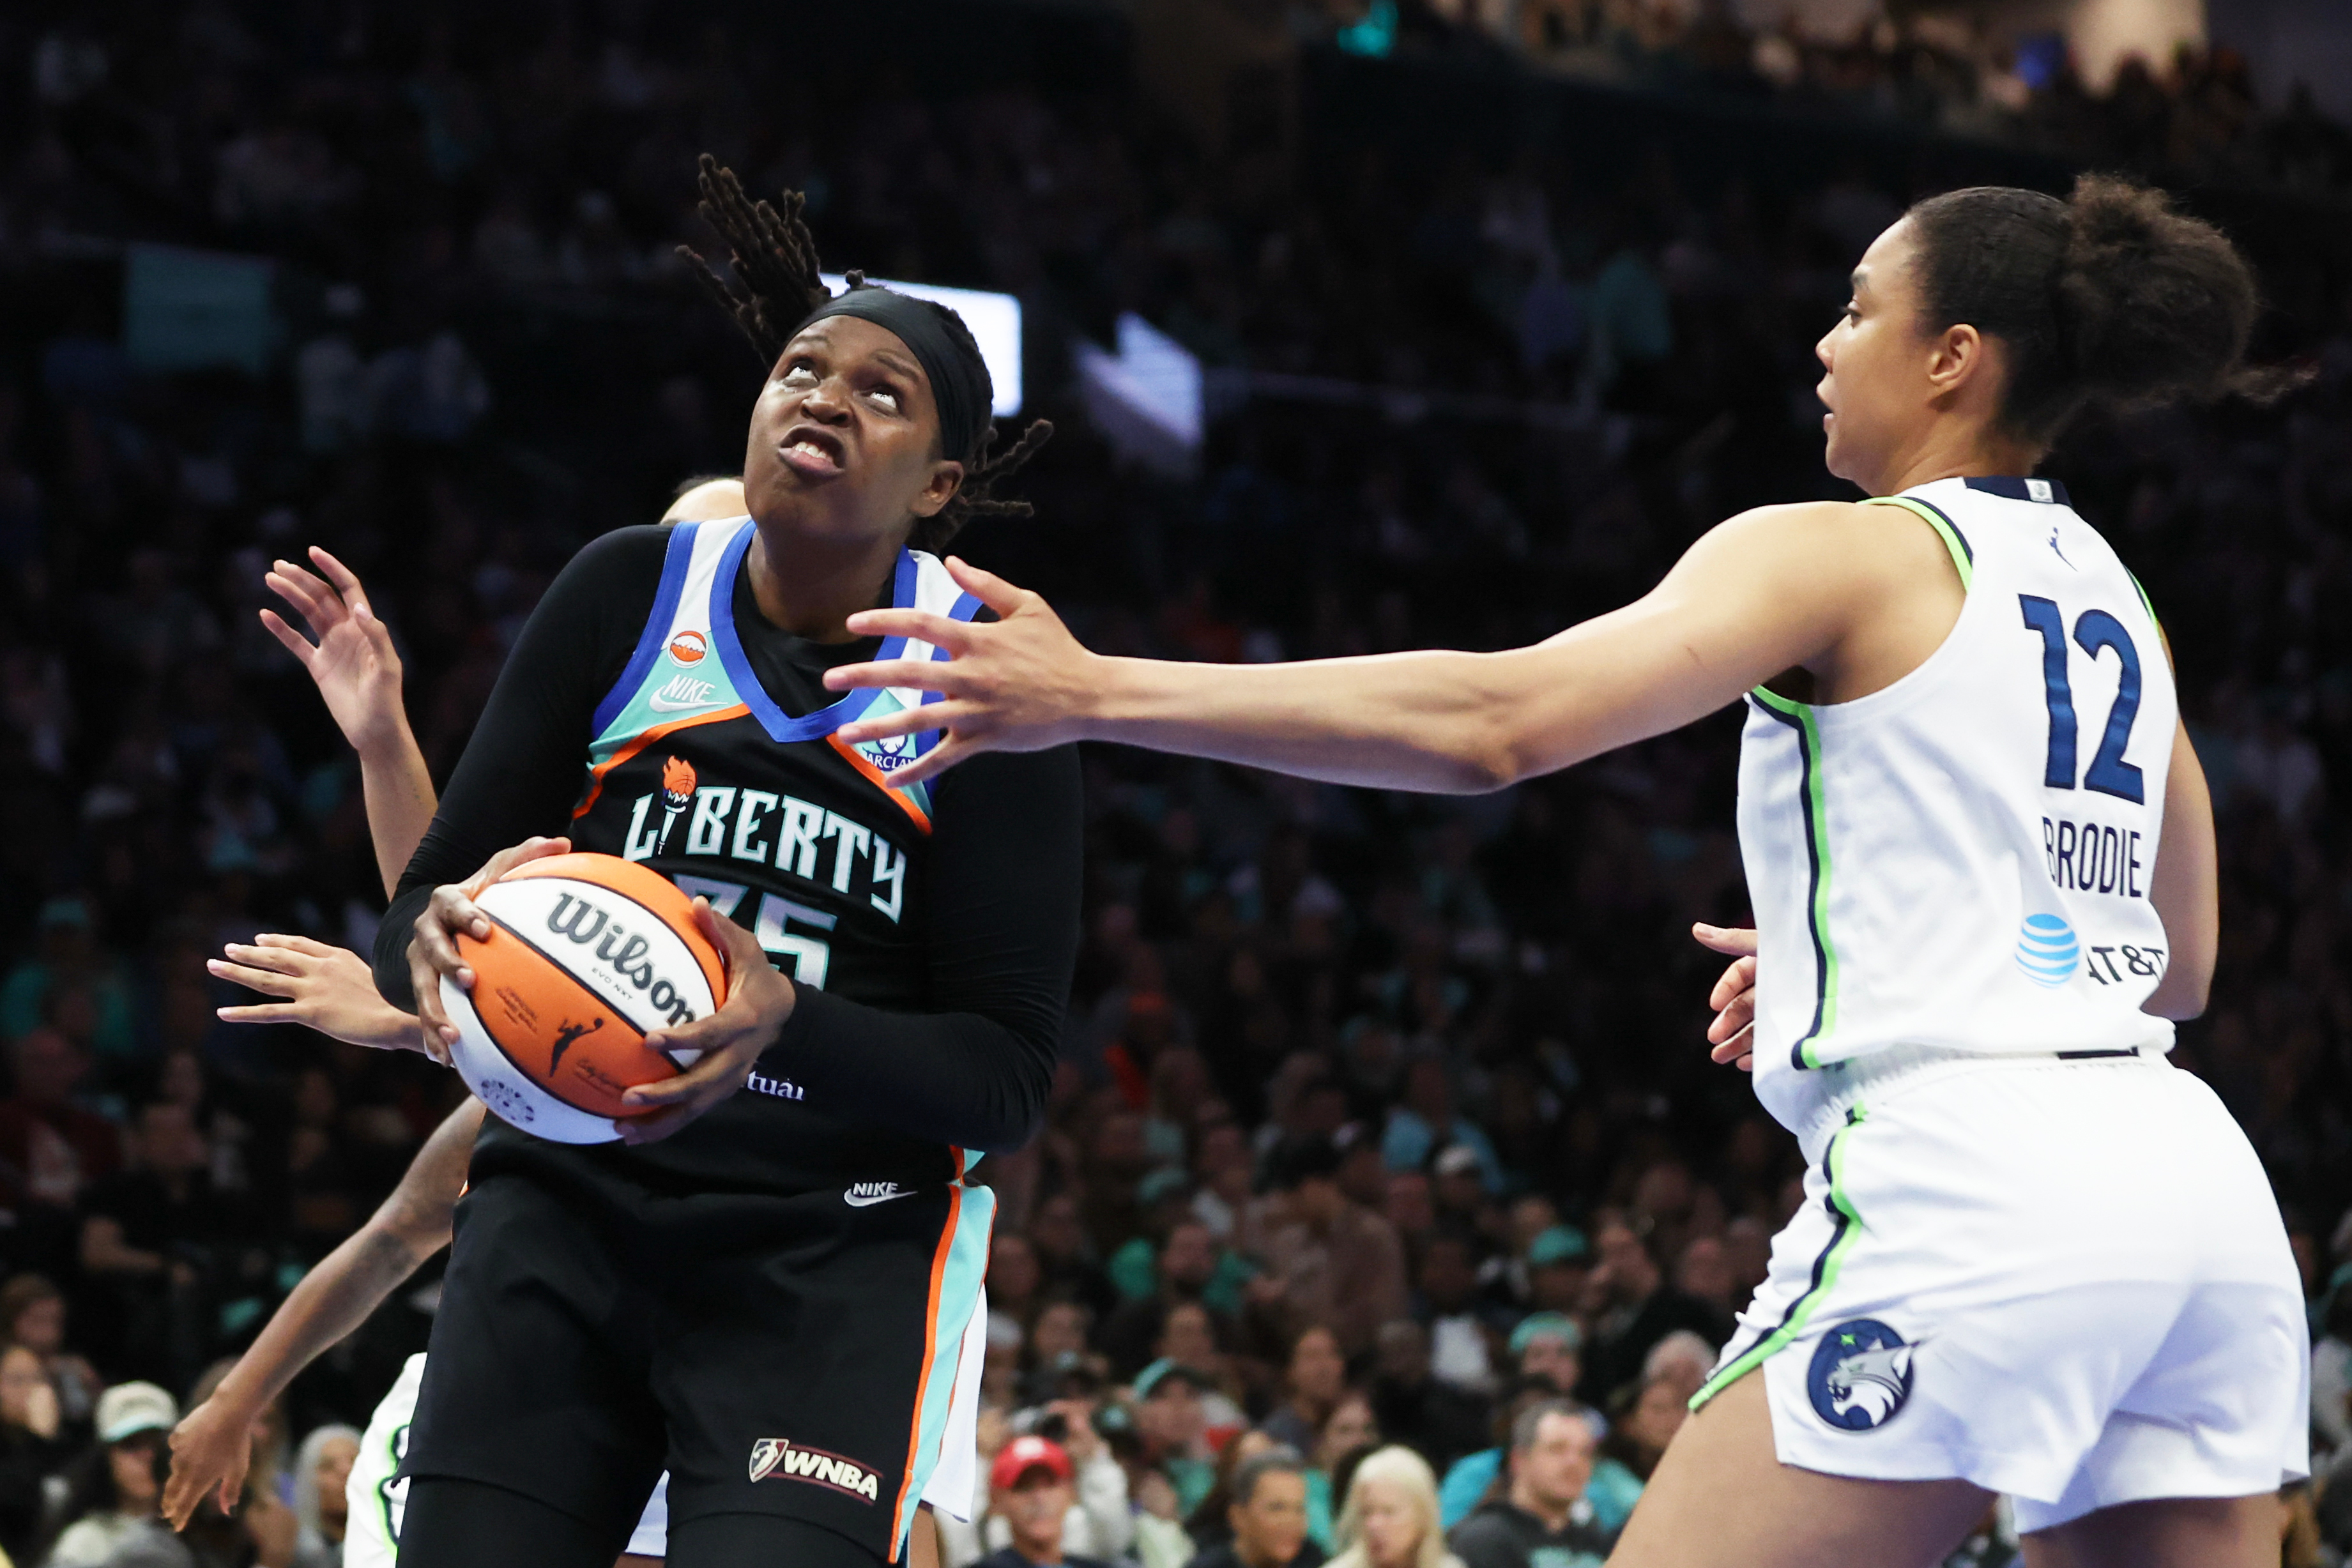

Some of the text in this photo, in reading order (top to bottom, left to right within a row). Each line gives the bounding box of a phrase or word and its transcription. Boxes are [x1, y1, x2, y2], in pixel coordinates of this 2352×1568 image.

[662, 674, 716, 703] NIKE
[2019, 593, 2144, 805] 12
[623, 755, 906, 923] LIBERTY
[2042, 816, 2142, 897] BRODIE
[547, 892, 696, 1026] Wilson
[591, 967, 634, 1001] EVO NXT
[853, 1182, 898, 1196] NIKE
[784, 1449, 878, 1502] WNBA
